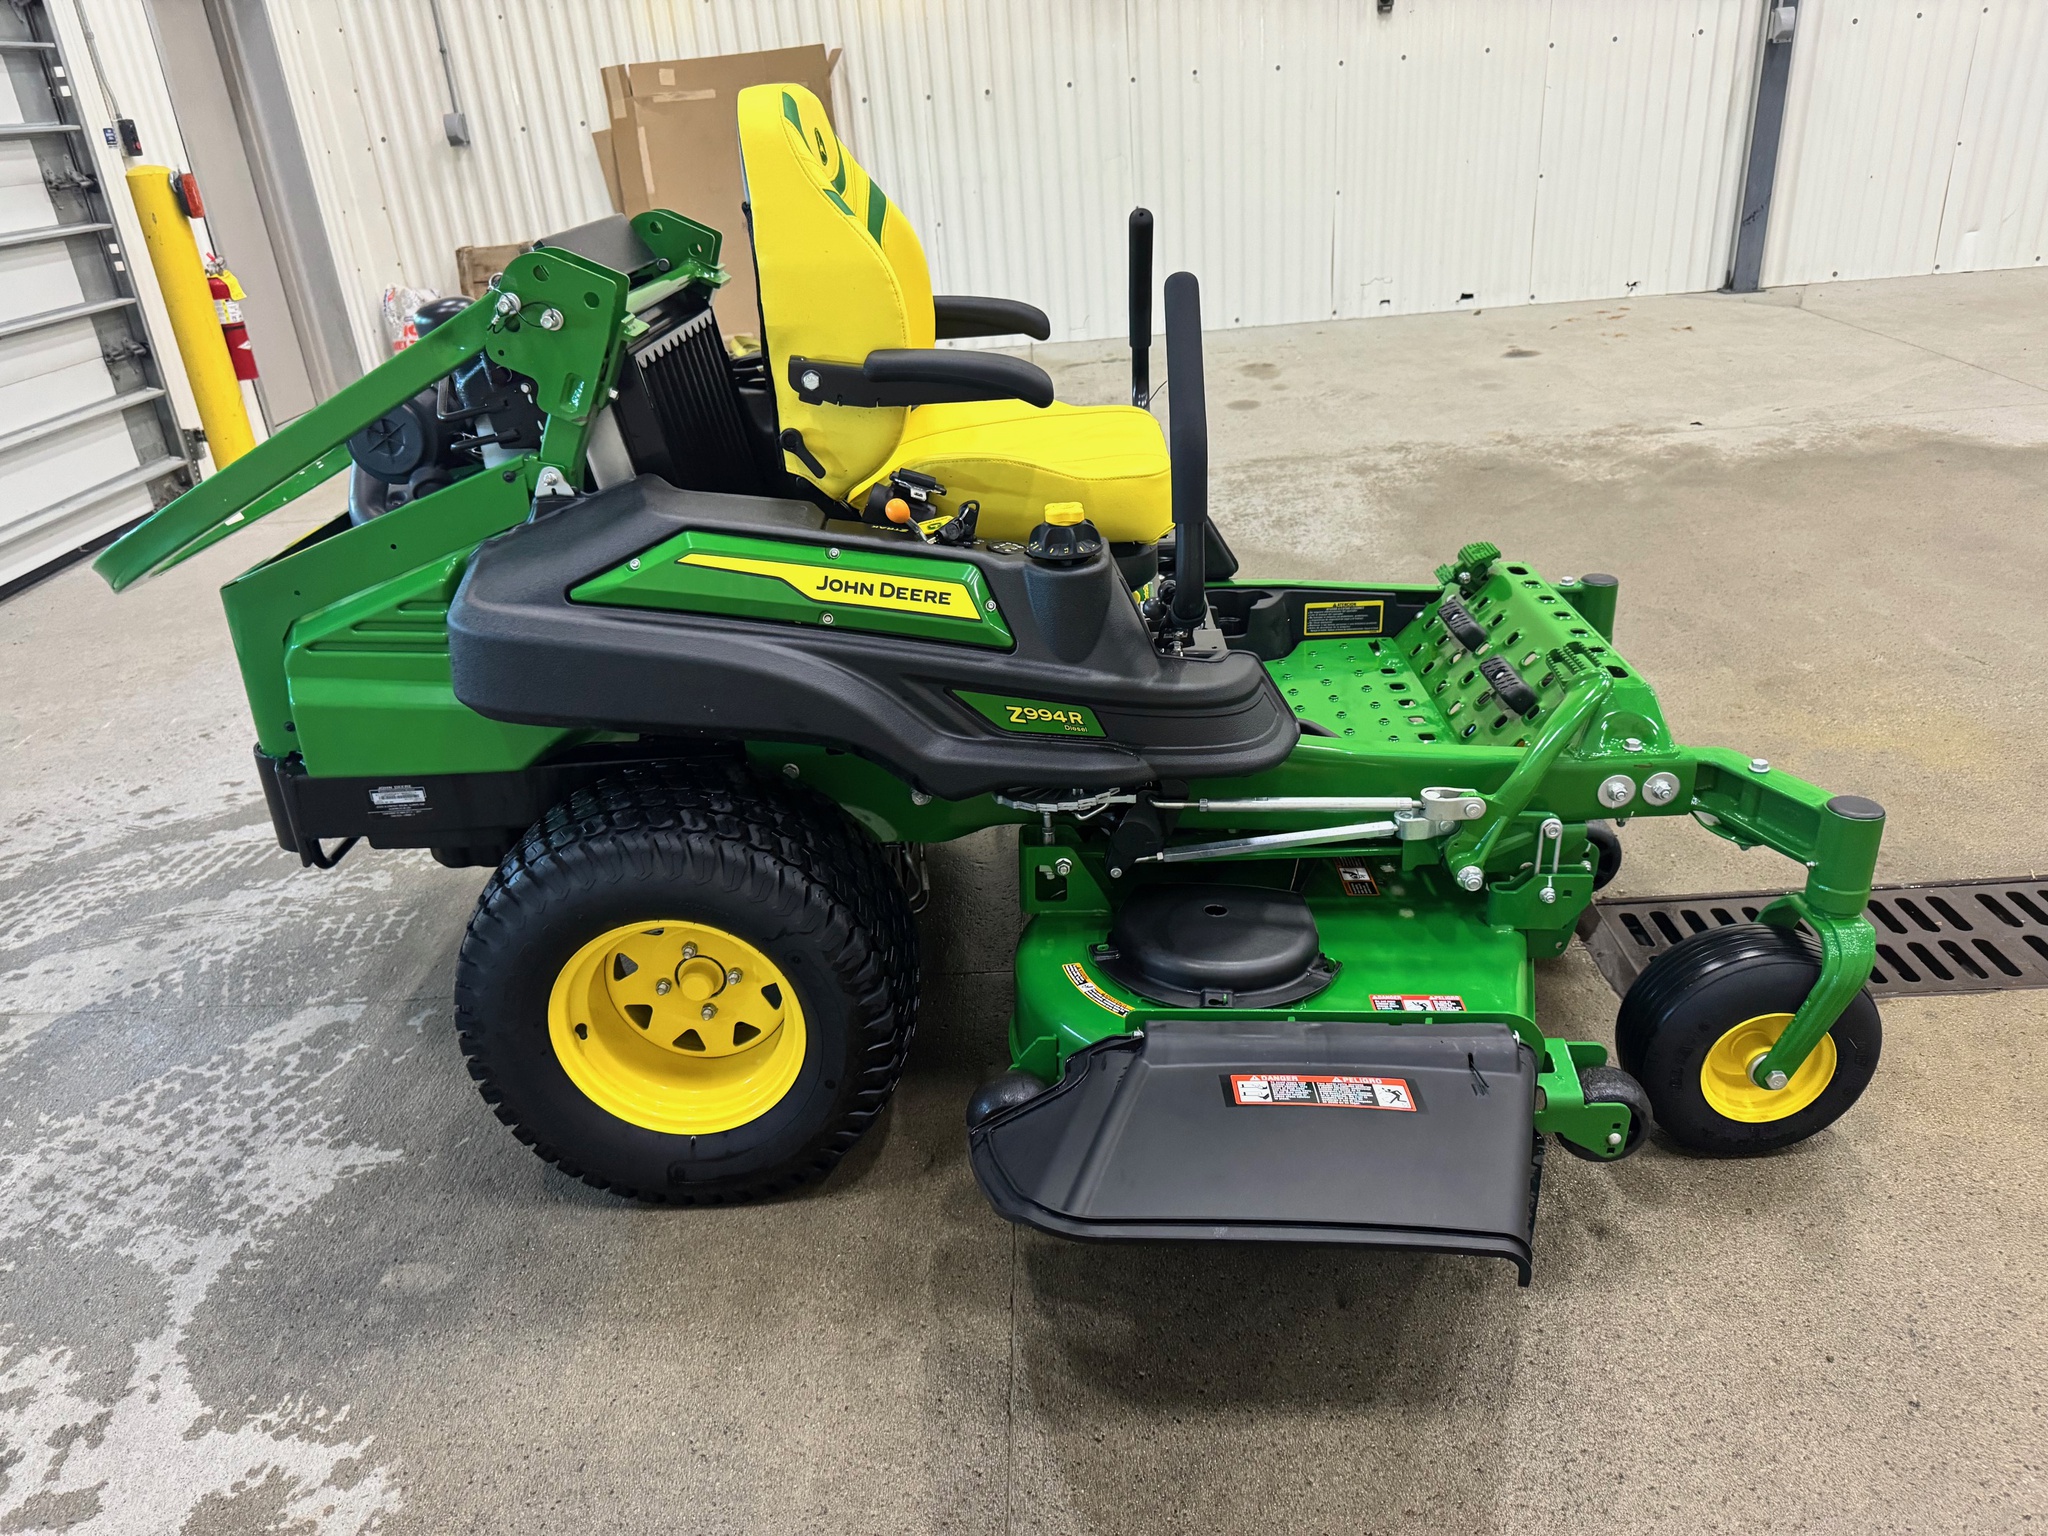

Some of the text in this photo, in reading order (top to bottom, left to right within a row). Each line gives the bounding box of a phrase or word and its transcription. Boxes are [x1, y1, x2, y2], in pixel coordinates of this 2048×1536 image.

[816, 575, 952, 606] JOHN DEERE
[1005, 705, 1084, 725] Z994R
[1064, 724, 1088, 733] Diesel
[1260, 1074, 1299, 1082] DANGER
[1342, 1076, 1383, 1085] PELIGRO
